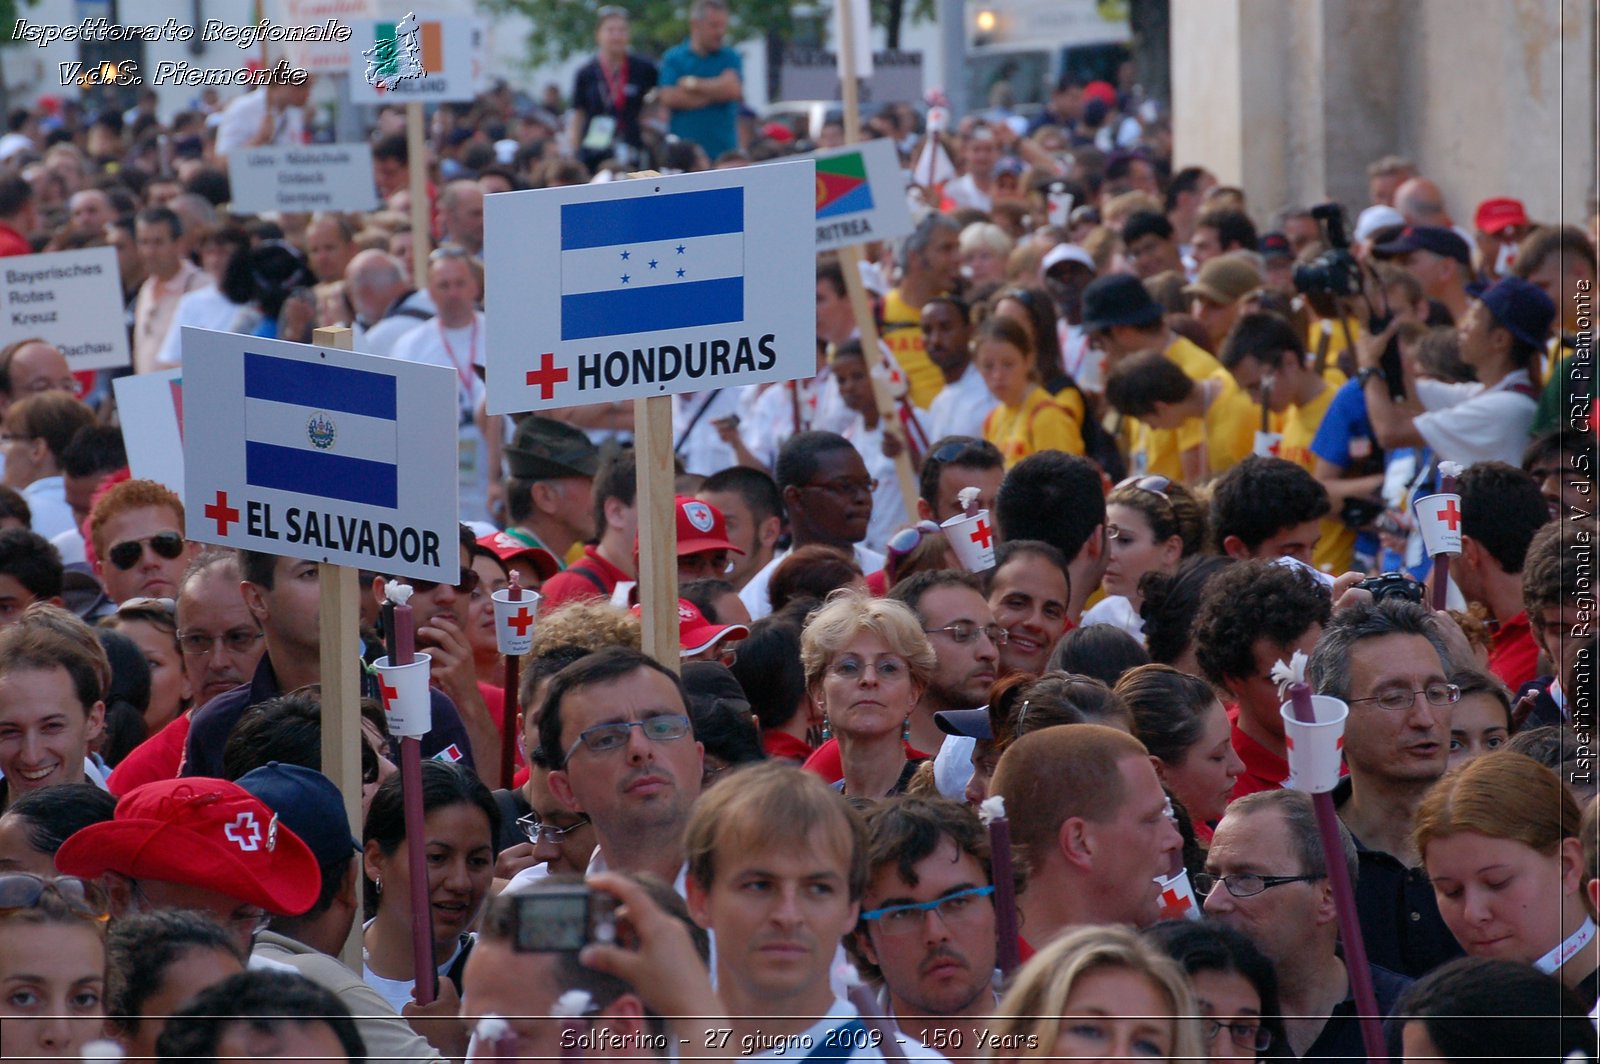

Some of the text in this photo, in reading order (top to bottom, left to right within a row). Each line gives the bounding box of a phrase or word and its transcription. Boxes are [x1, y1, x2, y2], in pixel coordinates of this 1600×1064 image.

[6, 264, 103, 284] Bayerisches
[8, 290, 55, 304] Rotes
[11, 311, 58, 325] Kreuz
[578, 334, 776, 390] HONDURAS
[247, 500, 441, 567] EL SALVADOR
